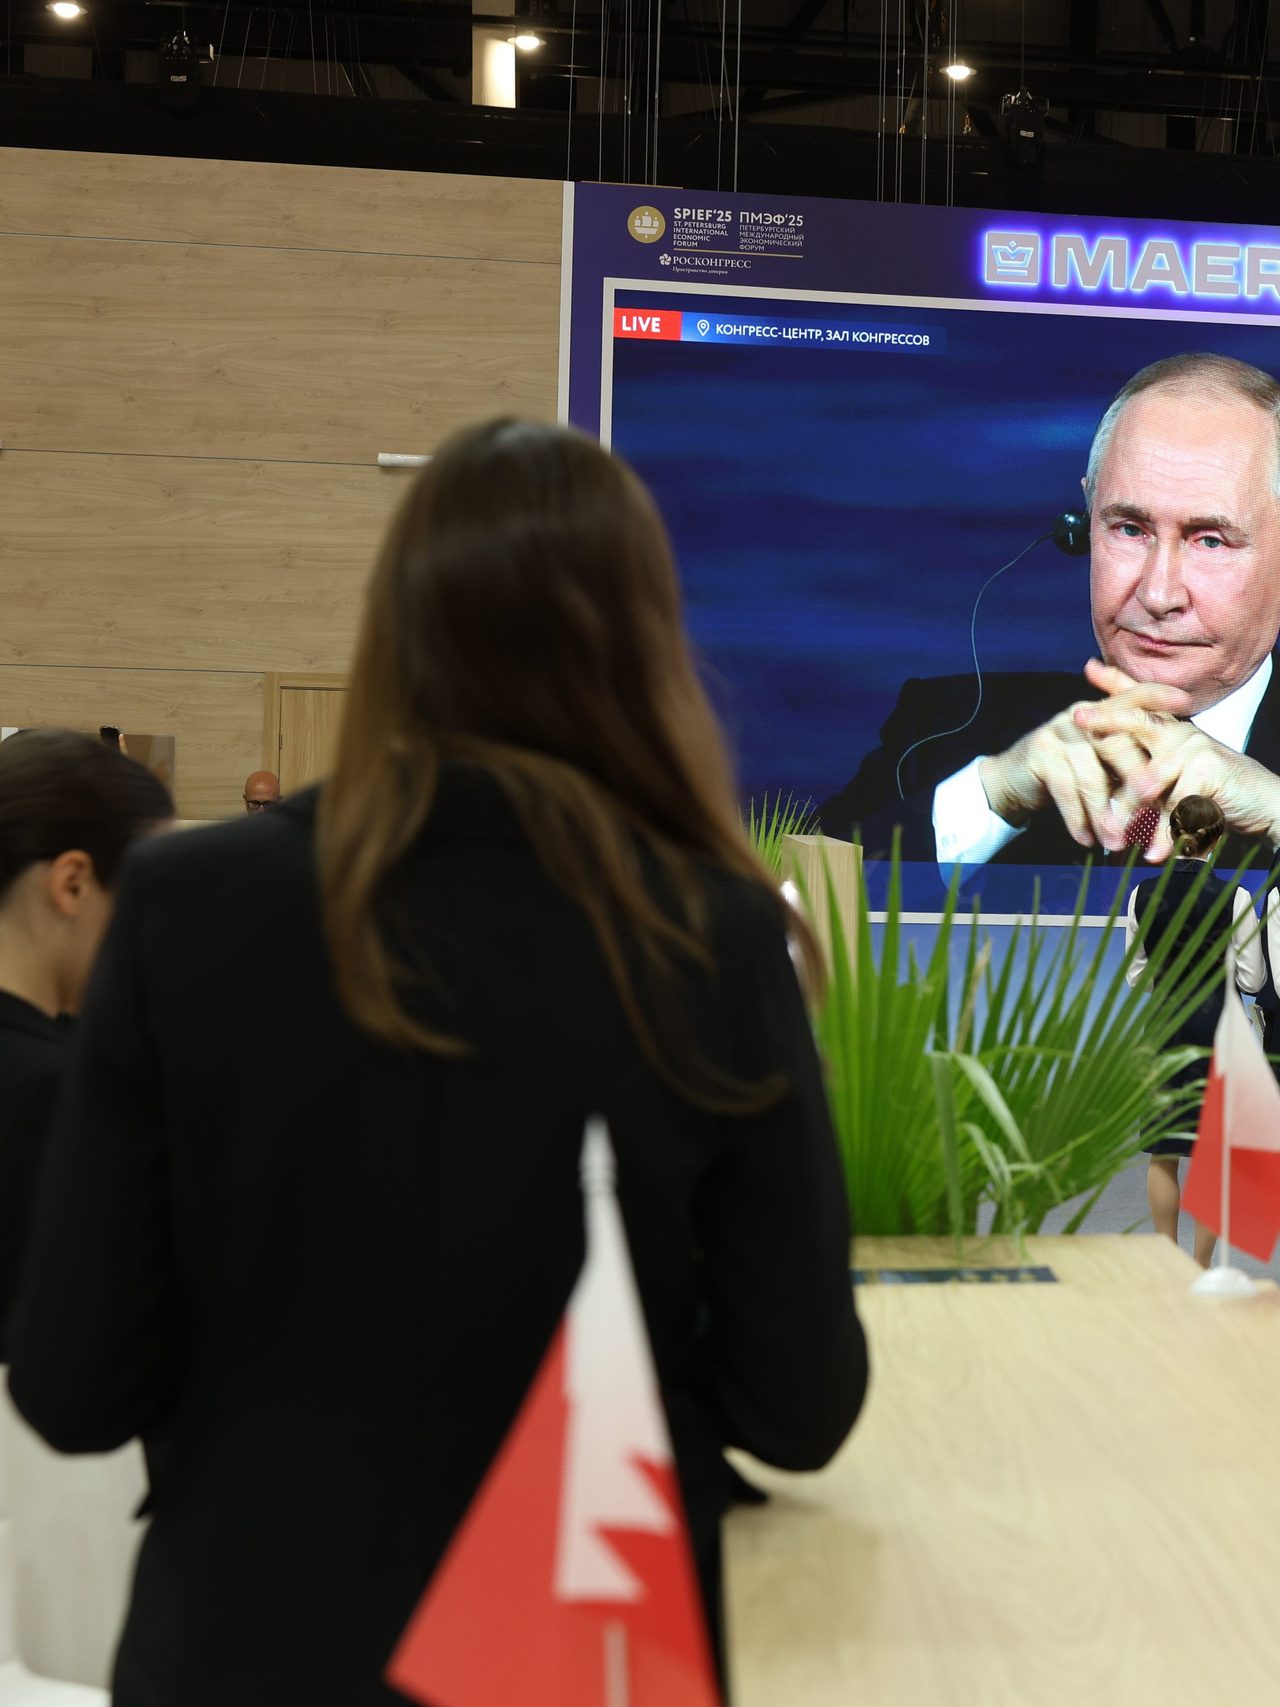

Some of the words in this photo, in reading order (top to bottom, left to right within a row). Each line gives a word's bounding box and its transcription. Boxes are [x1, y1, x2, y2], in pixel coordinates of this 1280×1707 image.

[684, 221, 727, 230] PETERSBURG
[739, 224, 796, 234] ПЕТЕРБУРГСКИЙ
[673, 228, 729, 237] INTERNATIONAL
[739, 231, 805, 241] МЕЖДУНАРОДНЫЙ
[673, 234, 711, 242] ECONOMIC
[739, 238, 803, 247] ЭКОНОМИЧЕСКИЙ
[673, 240, 698, 248] FORUM
[673, 256, 752, 269] РОСКОНГРЕСС
[621, 315, 661, 333] LIVE
[716, 323, 824, 343] КОНГРЕСС-ЦЕНТР,
[826, 330, 850, 342] ЗАЛ
[852, 331, 930, 346] КОНГРЕССОВ
